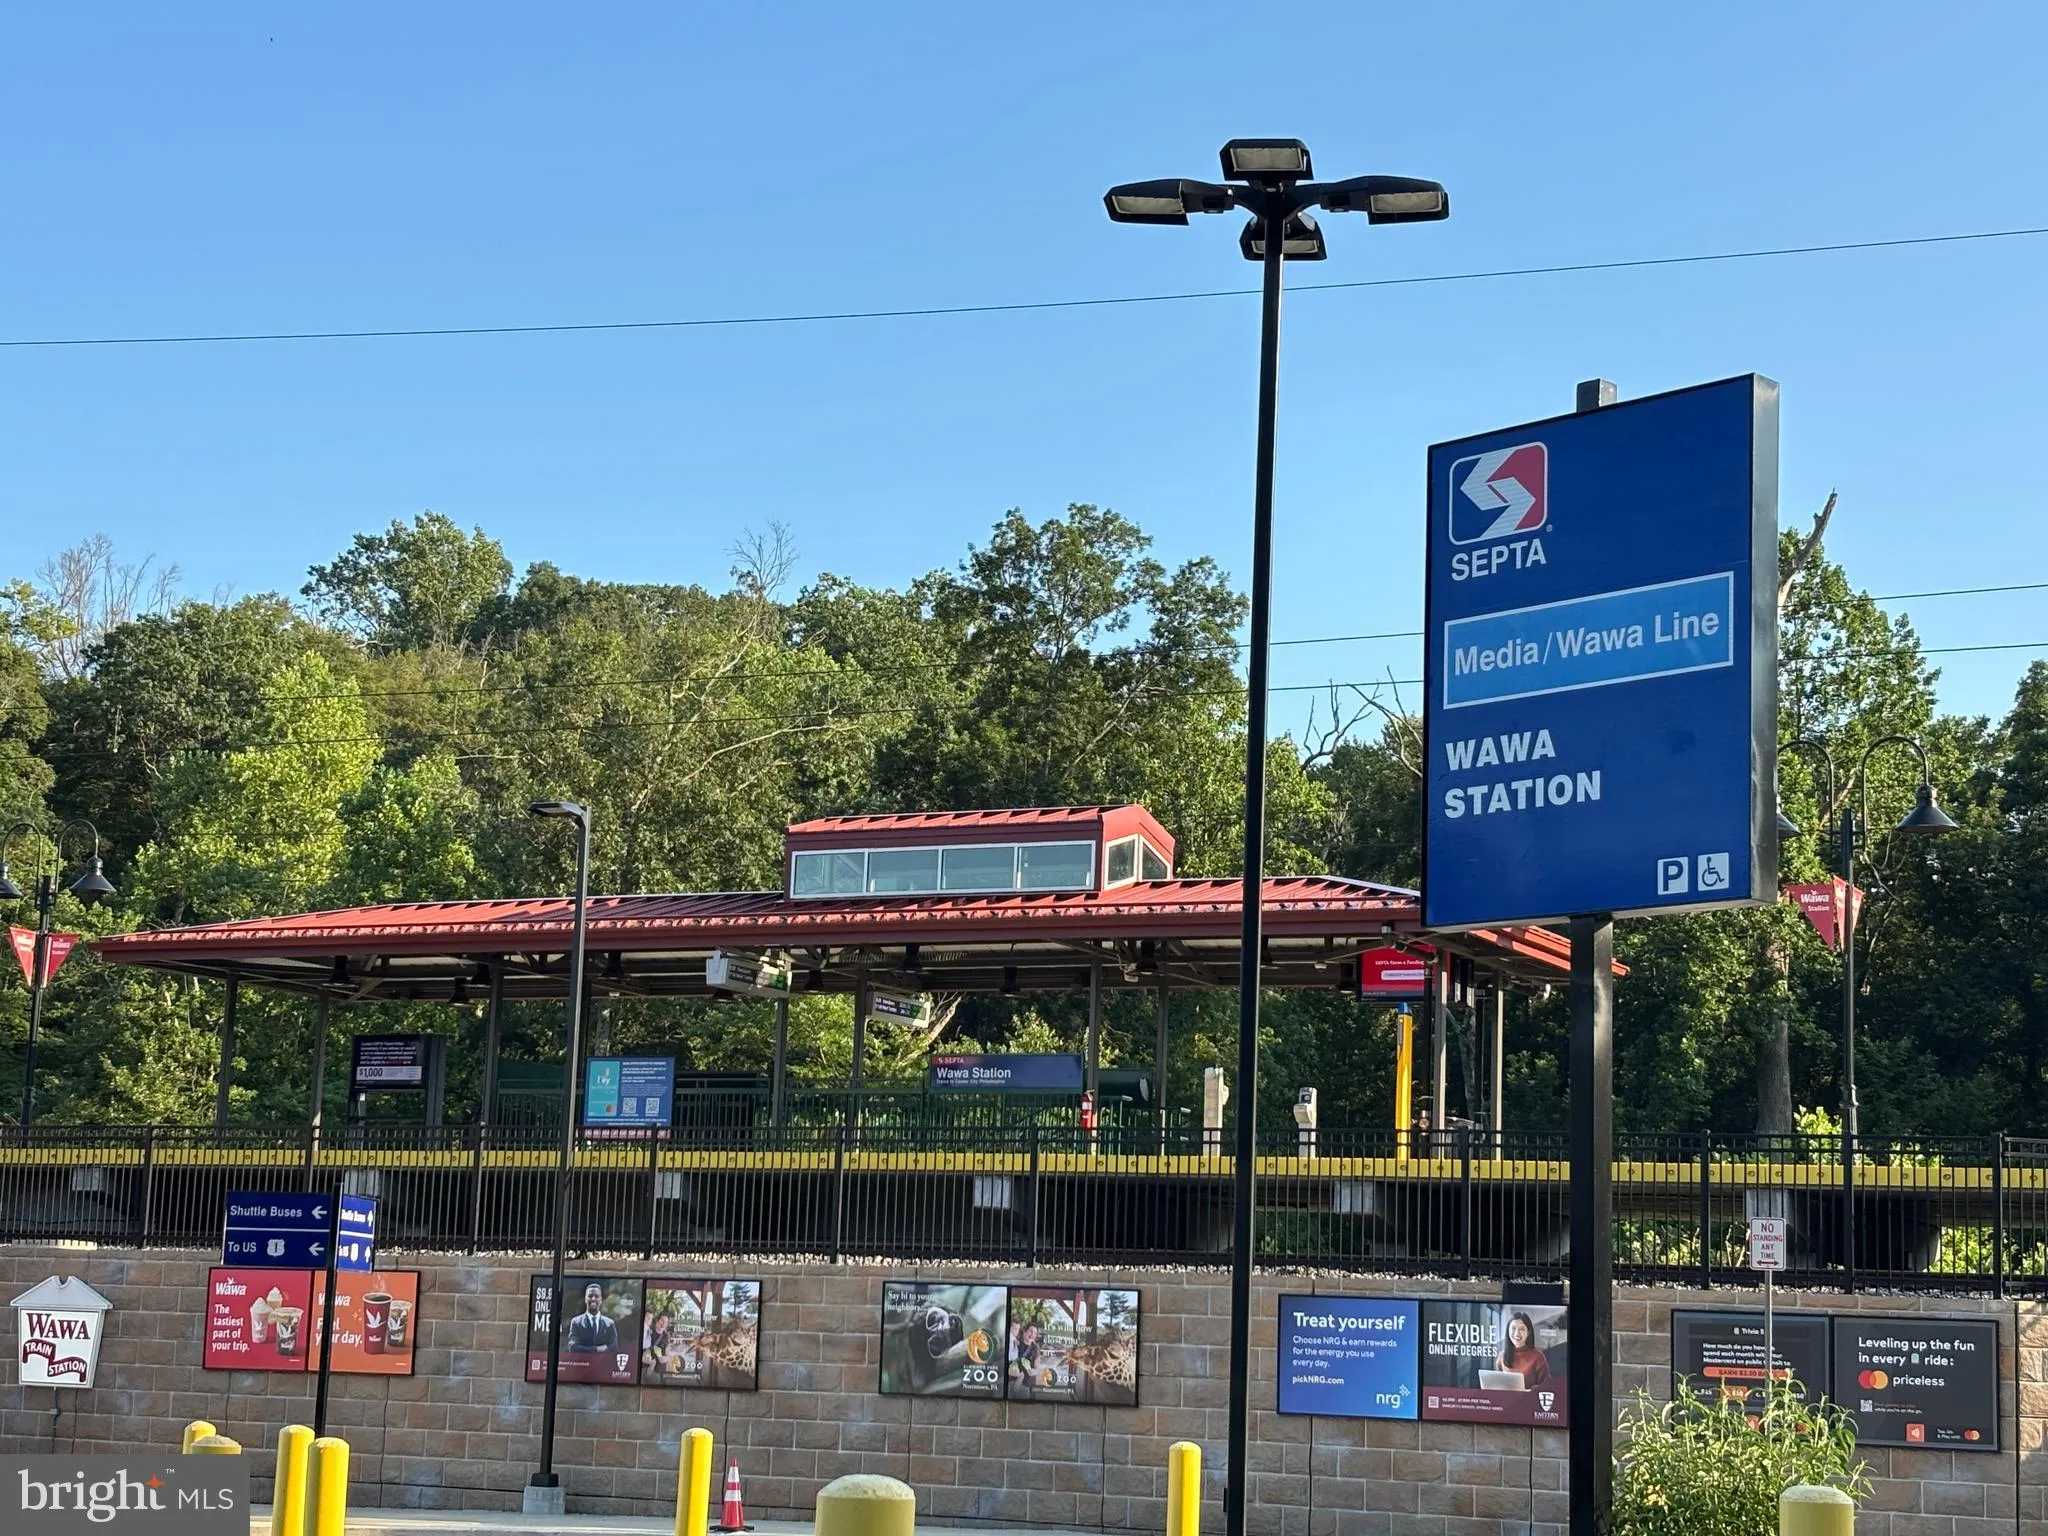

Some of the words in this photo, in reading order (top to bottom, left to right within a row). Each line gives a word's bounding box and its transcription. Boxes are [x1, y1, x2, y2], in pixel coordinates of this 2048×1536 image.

[1451, 538, 1547, 582] SEPTA
[1654, 611, 1720, 643] Line
[1445, 728, 1556, 772] WAWA
[1444, 769, 1602, 819] STATION
[1801, 894, 1829, 903] Wawa
[359, 1067, 383, 1078] $1,000
[937, 1067, 969, 1079] Wawa
[972, 1067, 1011, 1079] Station
[230, 1205, 267, 1217] Shuttle
[270, 1206, 303, 1218] Buses
[1761, 1223, 1774, 1233] NO
[227, 1241, 240, 1252] To
[243, 1242, 257, 1252] US
[215, 1282, 247, 1296] Wawa
[318, 1292, 352, 1306] Wwa
[888, 1290, 899, 1301] Say
[901, 1291, 908, 1300] hi
[917, 1293, 934, 1302] your
[215, 1304, 230, 1314] The
[26, 1312, 91, 1340] WAWA
[213, 1317, 244, 1326] tastiest
[1293, 1311, 1336, 1328] Treat
[1338, 1315, 1406, 1332] yourself
[212, 1329, 230, 1340] part
[232, 1328, 241, 1338] of
[1428, 1322, 1498, 1345] FLEXIBLE
[1742, 1327, 1760, 1335] Trivia
[341, 1331, 363, 1348] day.
[1064, 1337, 1078, 1346] you
[1292, 1335, 1322, 1345] Choose
[1323, 1336, 1340, 1346] NRG
[1342, 1337, 1347, 1346] &
[1367, 1339, 1397, 1347] rewards
[1858, 1336, 1909, 1351] Leveling
[1912, 1341, 1927, 1352] up
[1930, 1339, 1951, 1350] the
[1954, 1339, 1975, 1351] fun
[24, 1341, 54, 1356] TRAIN
[212, 1342, 231, 1352] your
[232, 1341, 250, 1353] trip.
[1292, 1347, 1303, 1355] for
[1305, 1348, 1317, 1356] the
[1318, 1349, 1344, 1359] energy
[1345, 1351, 1360, 1359] you
[1428, 1344, 1459, 1356] ONLINE
[1460, 1345, 1498, 1358] DEGREES
[1703, 1350, 1720, 1358] spend
[1858, 1352, 1869, 1363] in
[1872, 1354, 1906, 1367] every
[47, 1359, 87, 1376] STATION
[1292, 1360, 1314, 1368] every
[1315, 1359, 1330, 1369] day.
[1703, 1357, 1736, 1365] Mastercard
[1745, 1358, 1763, 1366] public
[963, 1369, 999, 1383] ZOO
[1292, 1375, 1345, 1385] pickNRG.com
[1893, 1374, 1945, 1387] priceless
[1376, 1393, 1400, 1409] nrg
